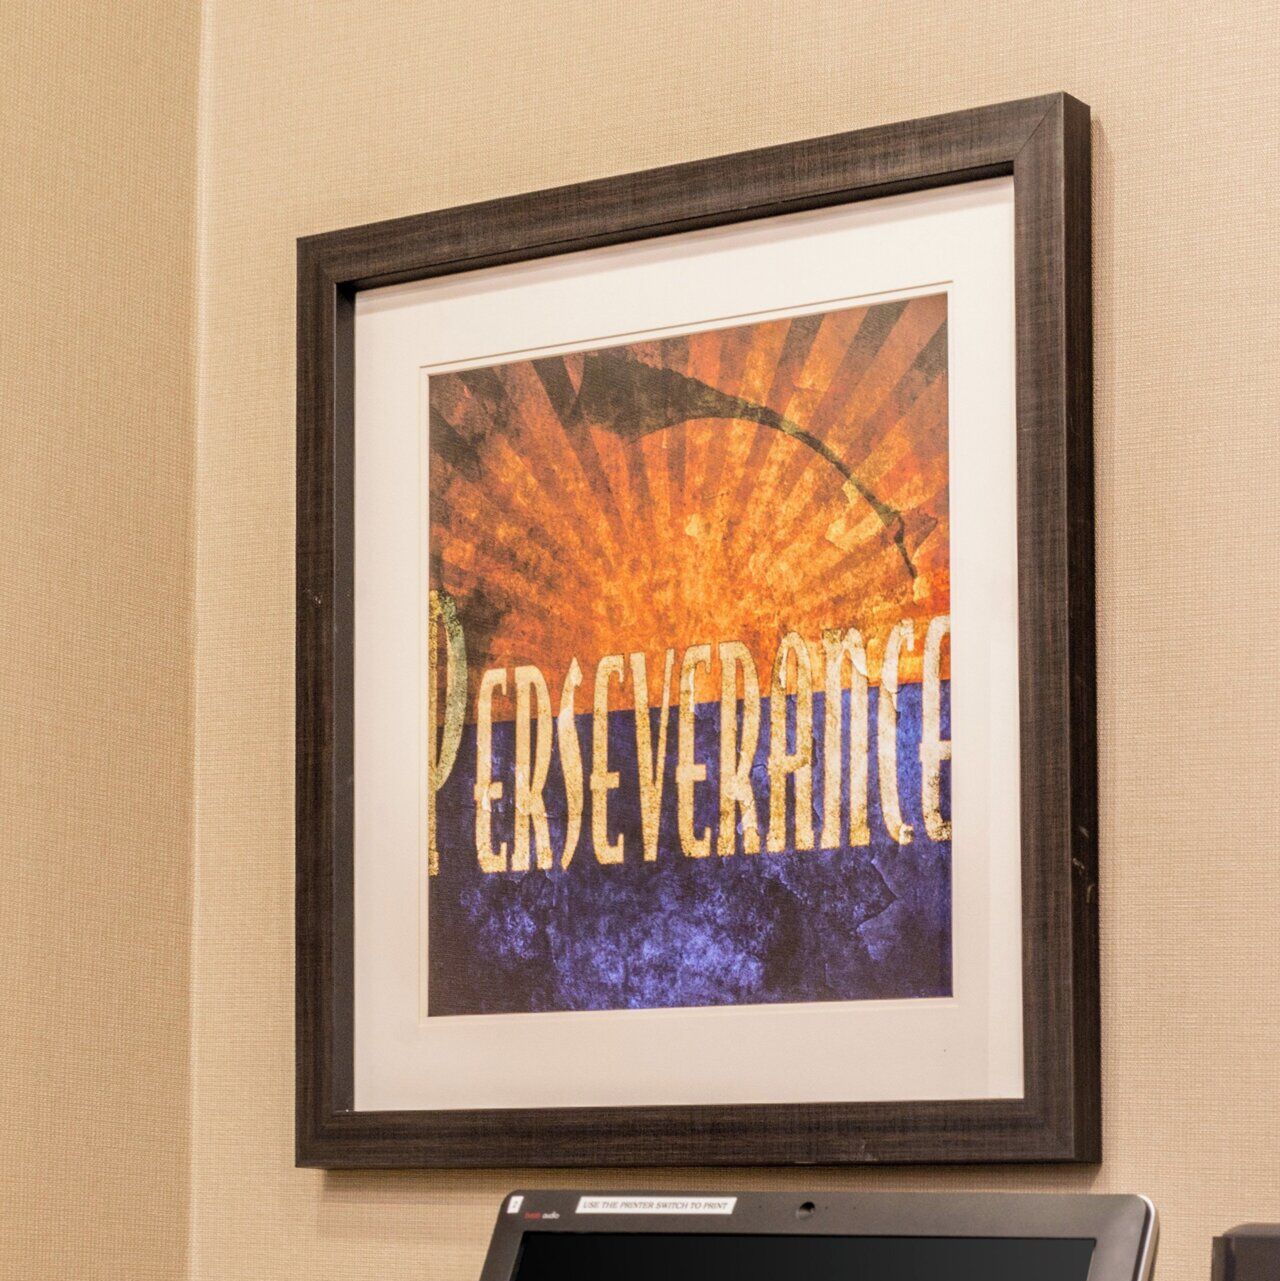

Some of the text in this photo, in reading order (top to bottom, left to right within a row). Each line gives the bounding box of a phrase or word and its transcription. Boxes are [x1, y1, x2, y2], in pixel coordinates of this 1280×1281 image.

[583, 1201, 728, 1210] USE THE PRINTER SWITCH TO PRINT
